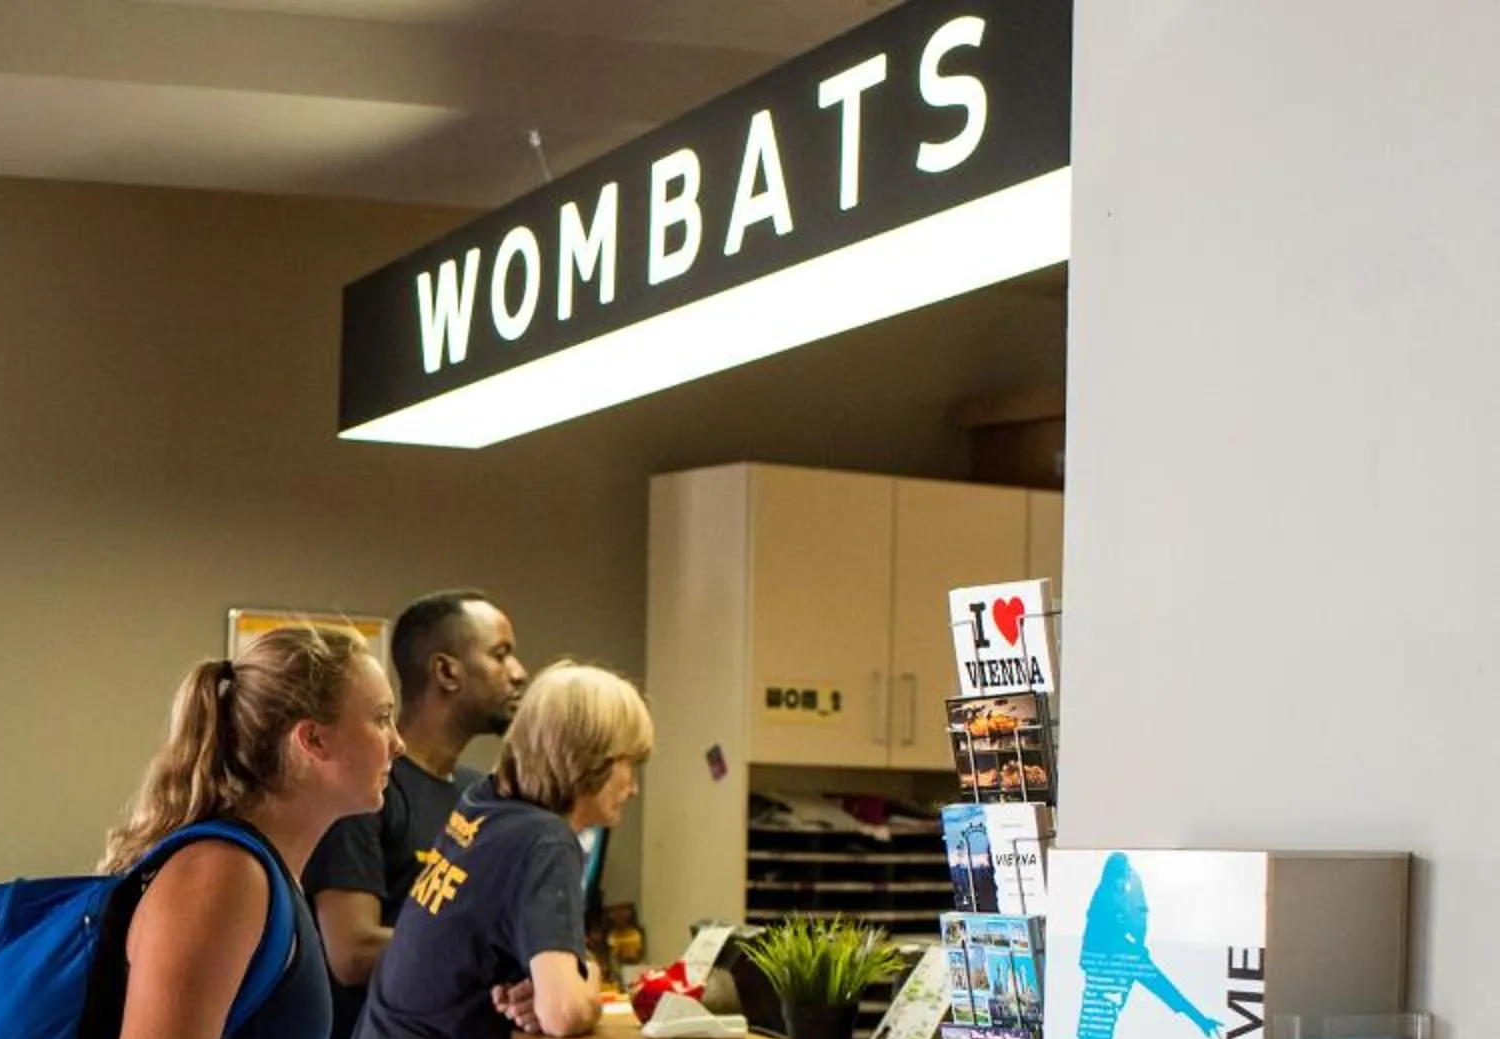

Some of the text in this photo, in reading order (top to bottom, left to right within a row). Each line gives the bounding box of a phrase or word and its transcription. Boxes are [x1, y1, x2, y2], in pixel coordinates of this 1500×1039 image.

[417, 15, 988, 375] WOMBATS
[969, 601, 990, 648] I
[965, 656, 1045, 688] VIENNA
